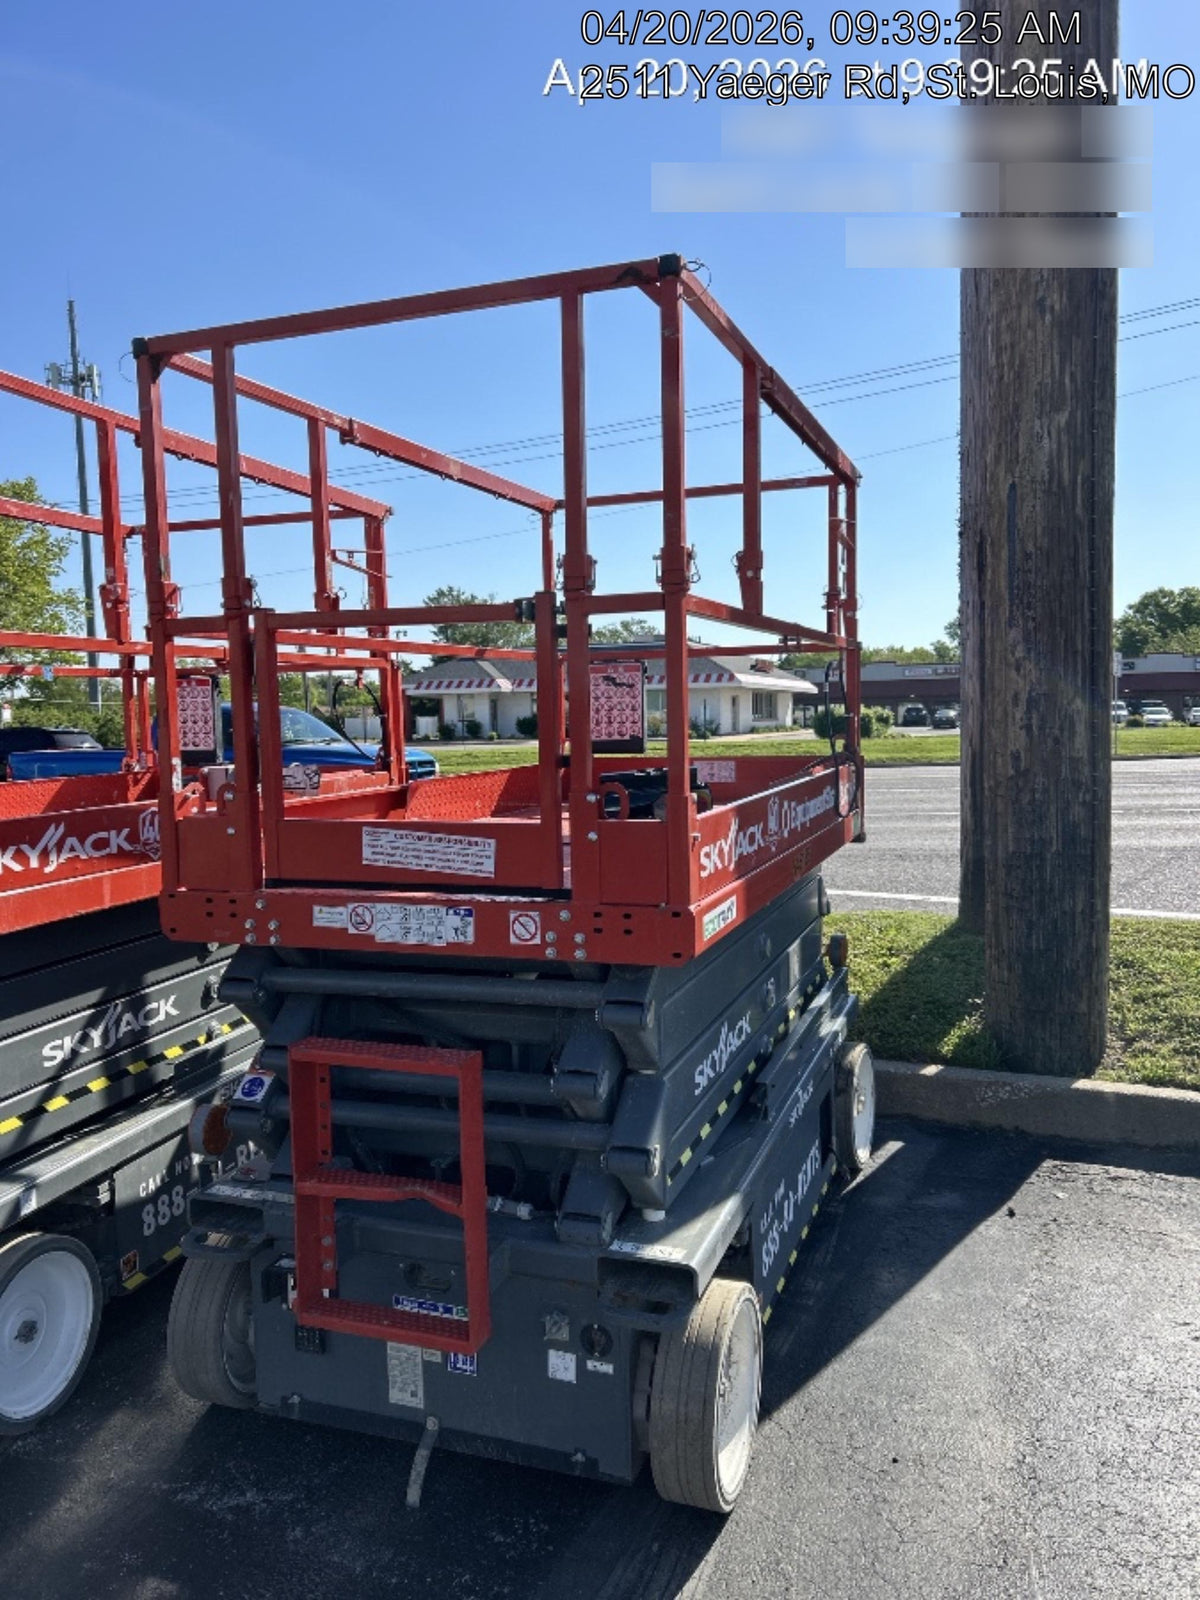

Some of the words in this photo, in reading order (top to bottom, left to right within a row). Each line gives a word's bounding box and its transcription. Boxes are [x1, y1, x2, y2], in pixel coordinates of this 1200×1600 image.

[0, 821, 131, 874] KYJACK
[700, 817, 765, 878] SKYJACK
[42, 994, 180, 1068] SKYJACK
[694, 1011, 751, 1096] SKYJACK
